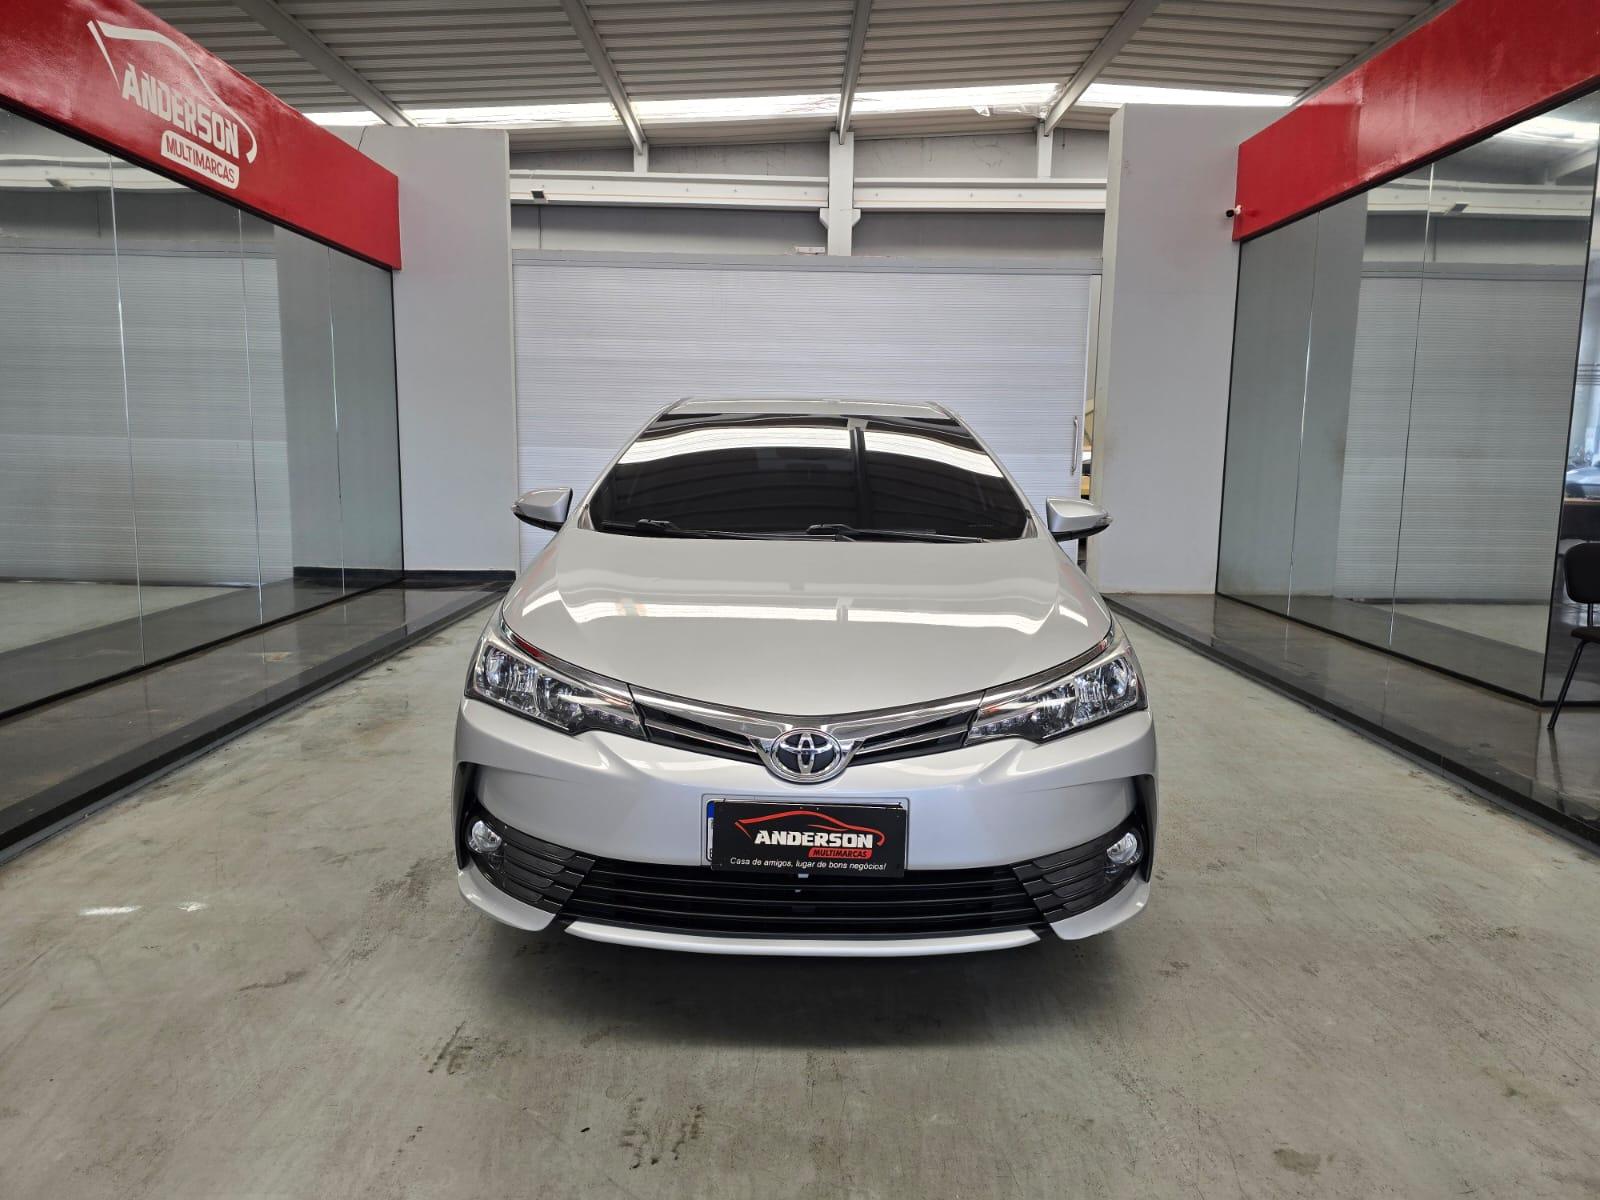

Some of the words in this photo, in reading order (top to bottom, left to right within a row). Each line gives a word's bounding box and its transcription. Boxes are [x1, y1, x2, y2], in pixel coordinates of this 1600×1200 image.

[121, 62, 239, 159] ANDERSON
[165, 134, 235, 184] MULTIMARCAS
[754, 830, 873, 848] ANDERSON
[812, 848, 868, 858] MULTIMARCAS
[730, 856, 750, 865] Casa
[752, 858, 762, 866] de
[763, 859, 793, 868] amigos,
[796, 860, 815, 869] lugar
[816, 861, 827, 869] de
[828, 861, 848, 869] bons
